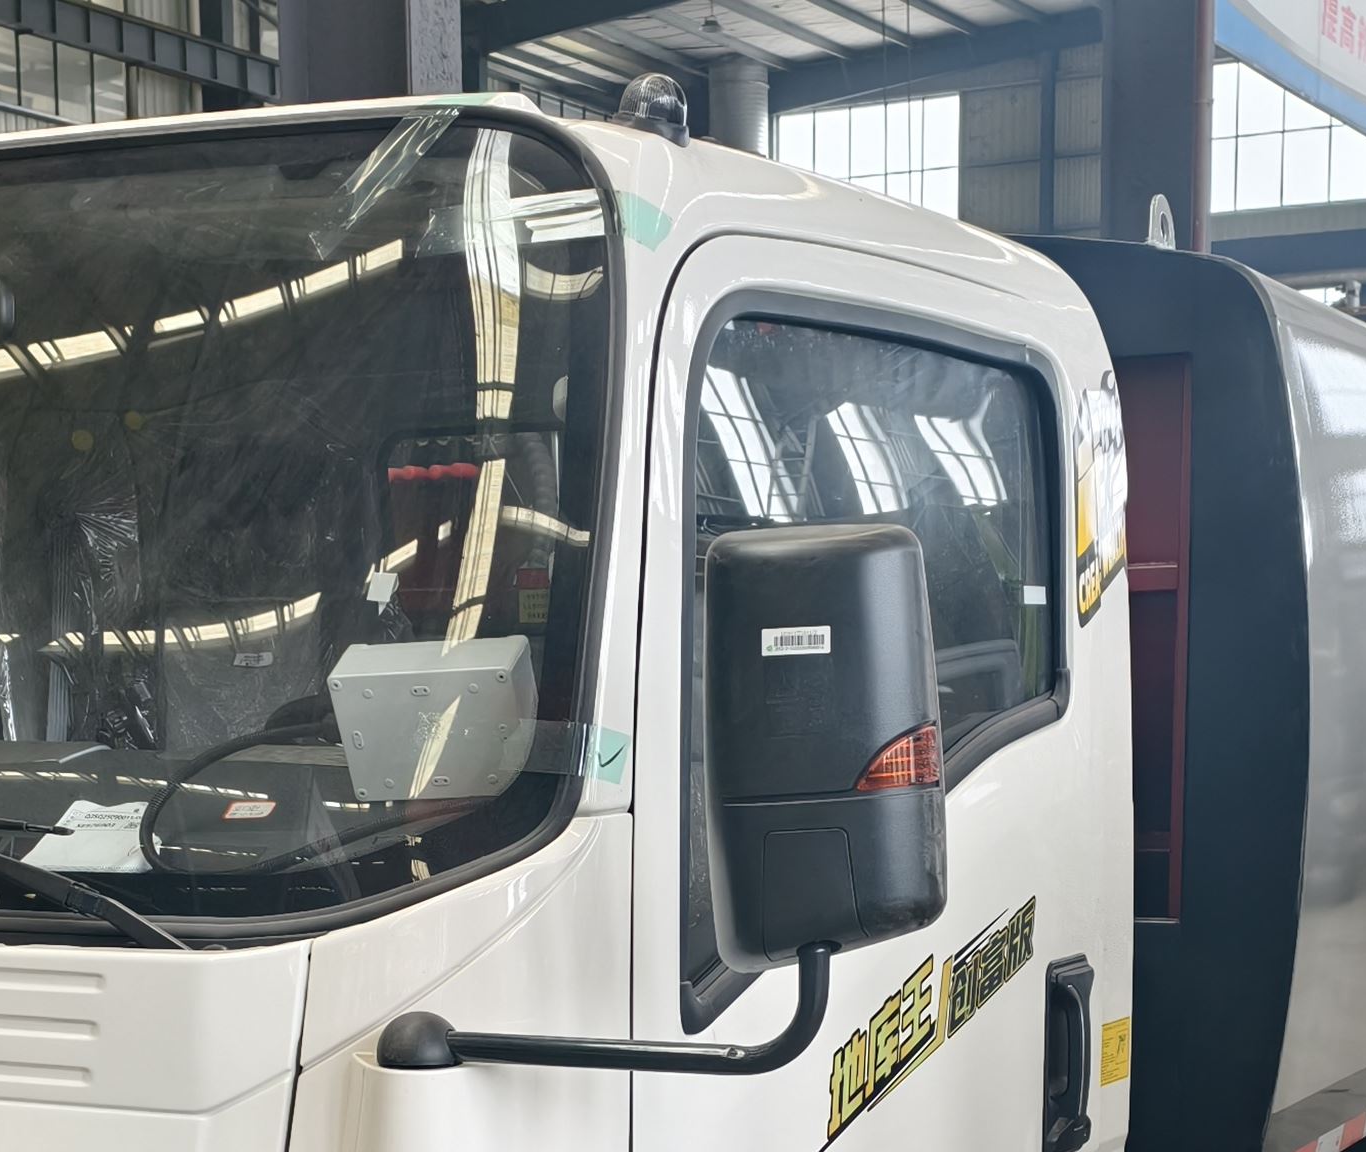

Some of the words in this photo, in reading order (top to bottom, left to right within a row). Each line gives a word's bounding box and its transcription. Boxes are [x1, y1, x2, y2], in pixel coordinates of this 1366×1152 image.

[827, 952, 935, 1141] 地库王
[947, 894, 1036, 1040] 创富版
